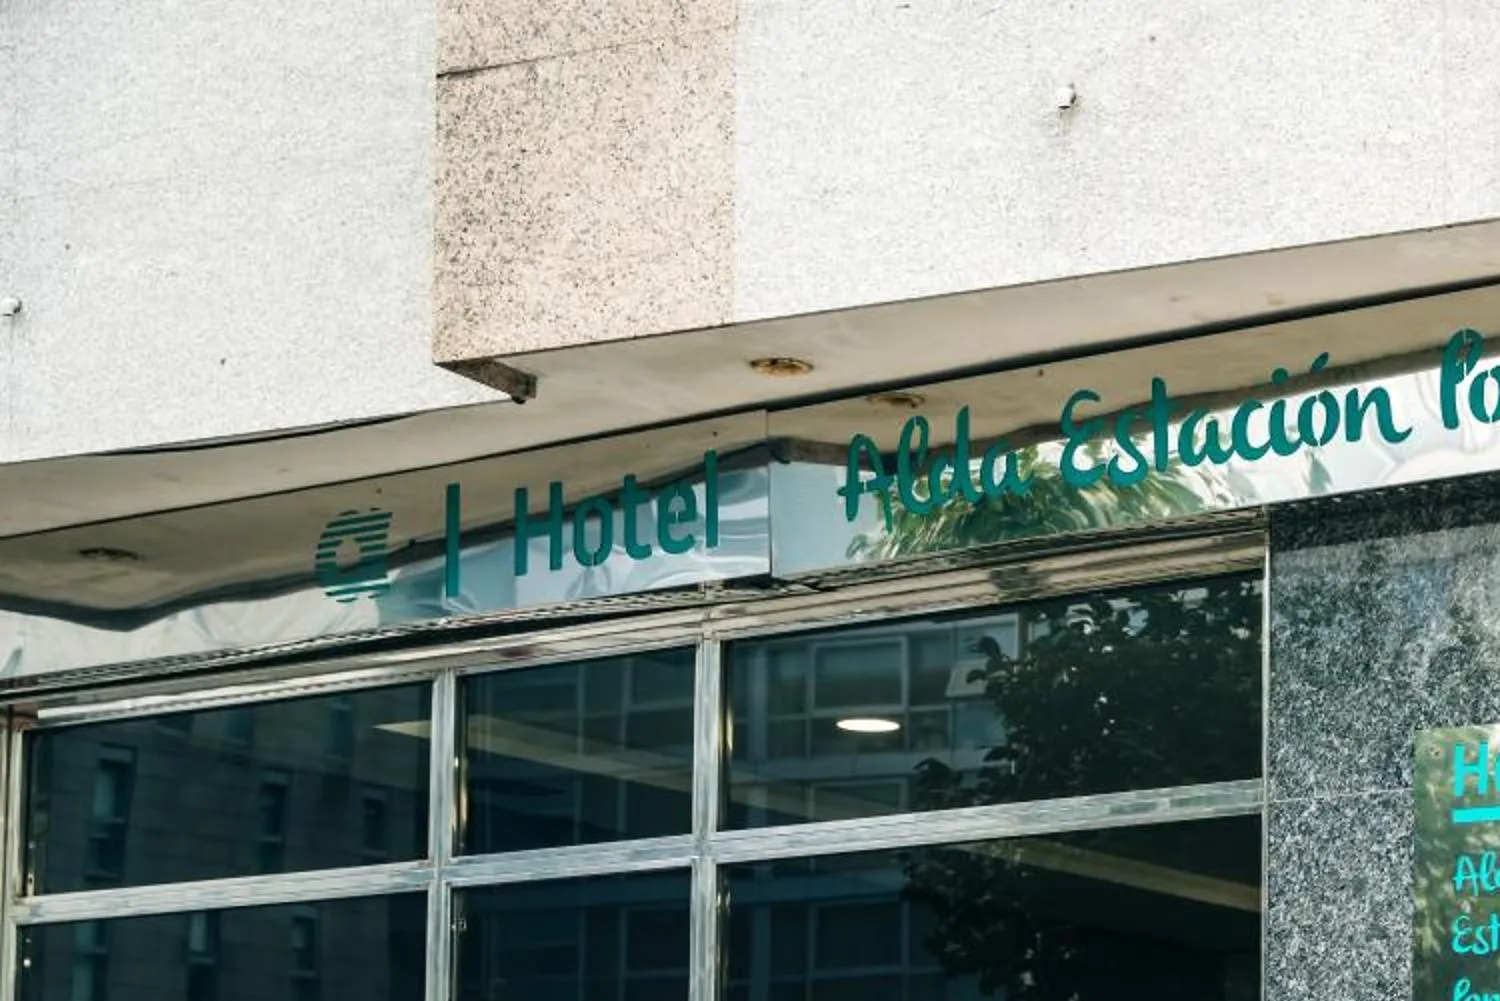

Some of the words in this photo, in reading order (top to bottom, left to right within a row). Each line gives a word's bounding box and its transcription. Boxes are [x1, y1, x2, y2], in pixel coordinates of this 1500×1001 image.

[514, 449, 719, 577] Hotel
[838, 413, 1032, 523] Alda
[1060, 352, 1412, 490] Estación
